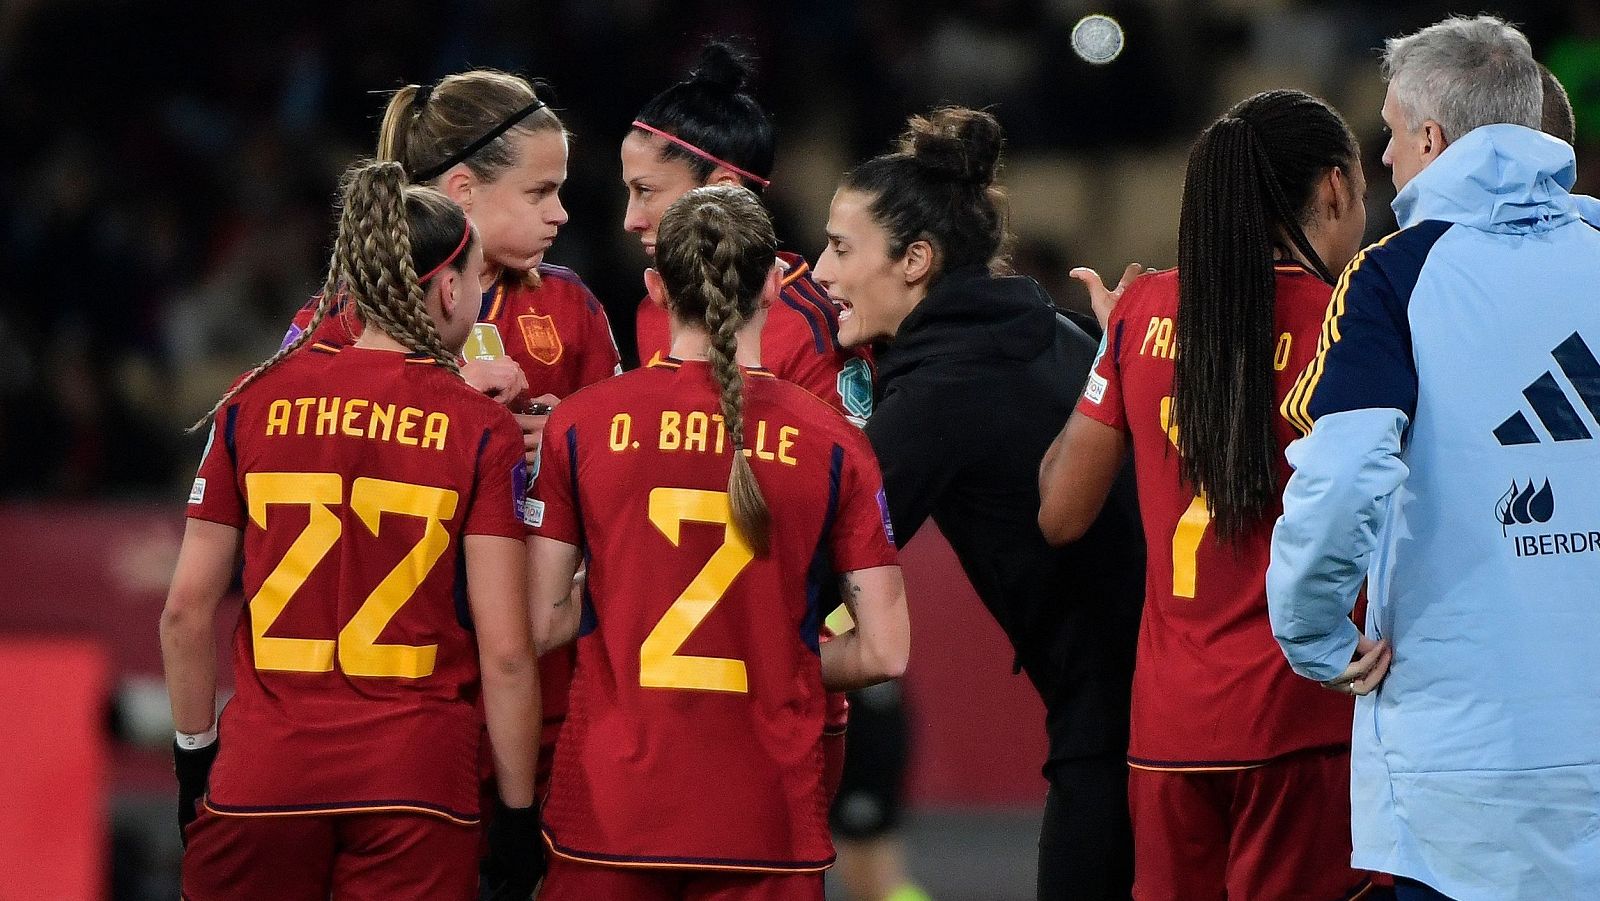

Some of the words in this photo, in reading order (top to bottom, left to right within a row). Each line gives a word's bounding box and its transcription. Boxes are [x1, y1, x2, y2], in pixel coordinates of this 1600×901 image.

[265, 396, 450, 451] ATHENEA
[609, 412, 640, 452] O.
[658, 410, 799, 466] BATLE
[245, 472, 459, 679] 22
[638, 487, 756, 694] 2
